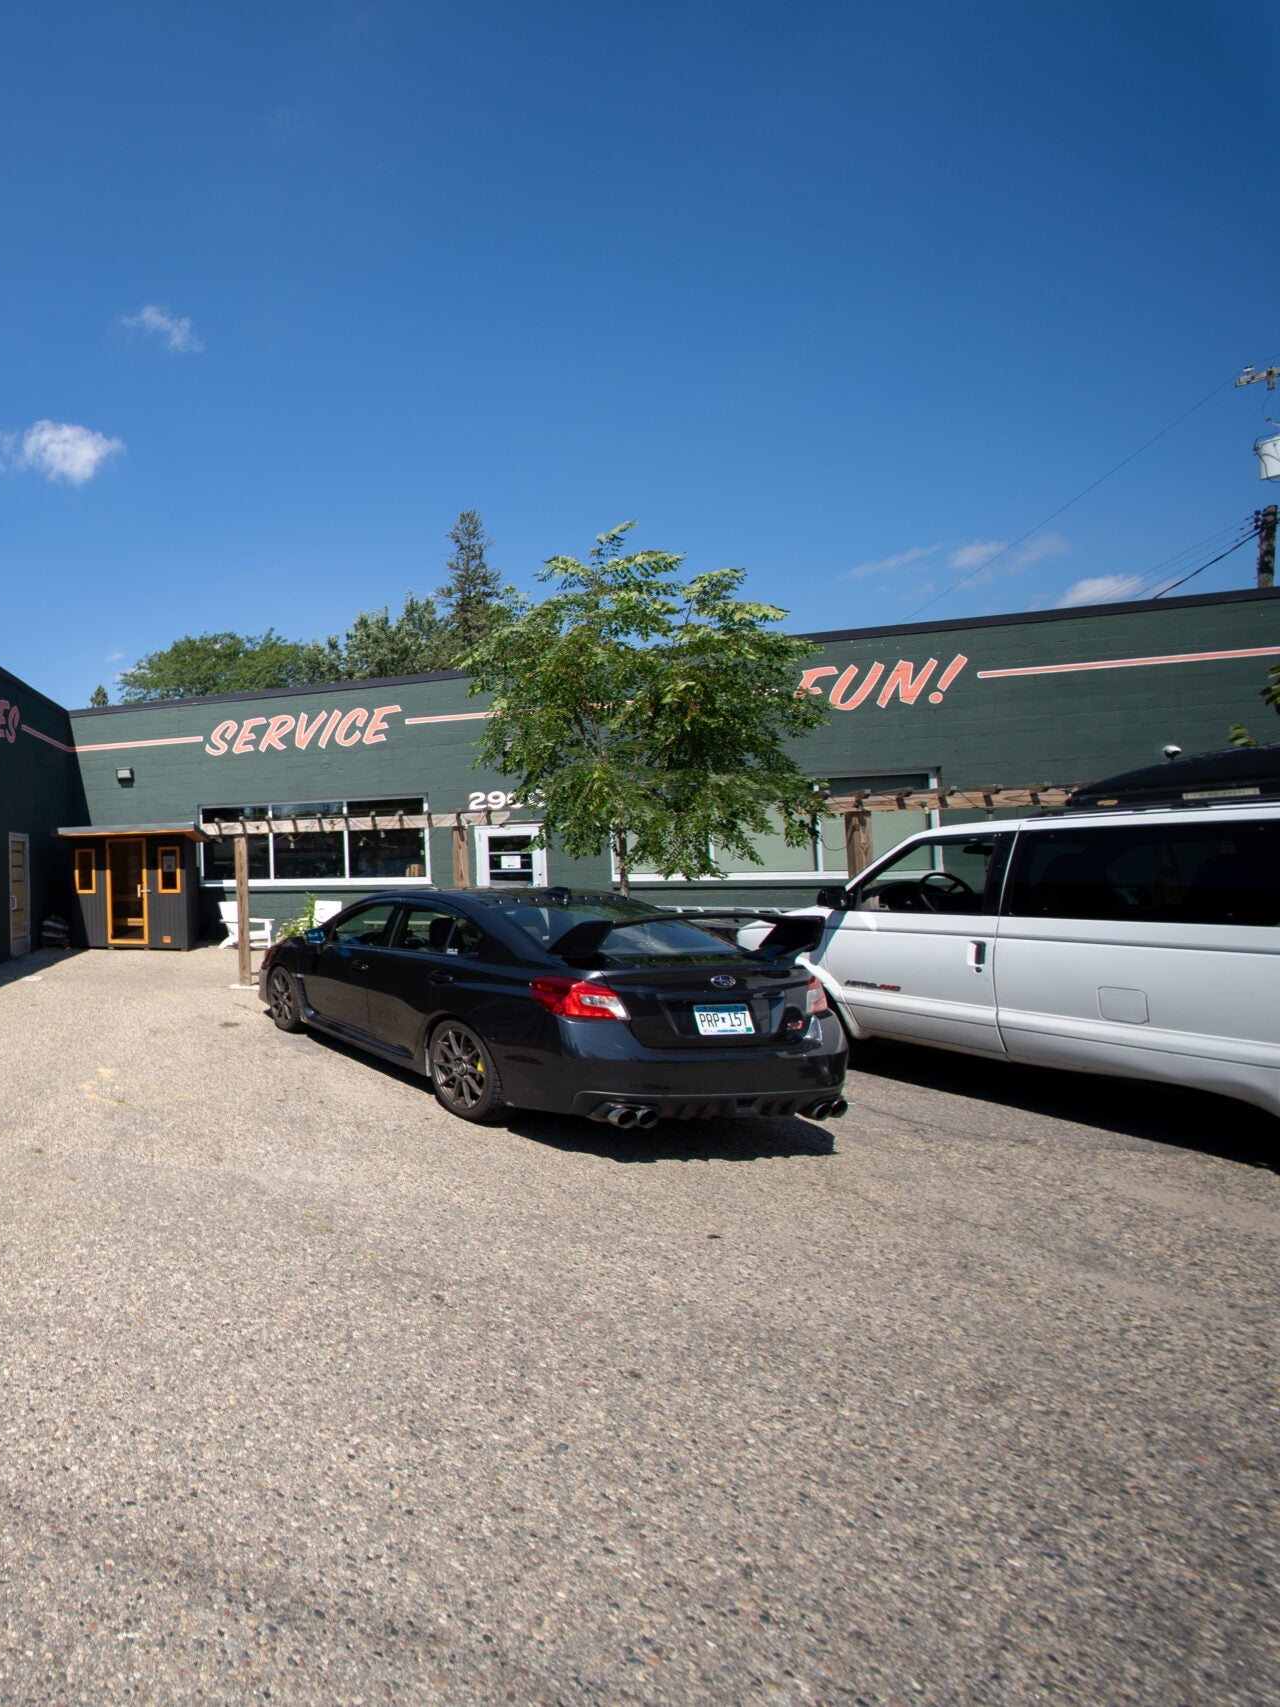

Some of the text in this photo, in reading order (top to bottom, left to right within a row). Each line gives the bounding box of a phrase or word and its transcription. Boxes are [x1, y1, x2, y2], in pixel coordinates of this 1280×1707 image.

[793, 654, 968, 710] FUN!
[205, 705, 403, 756] SERVICE
[699, 1012, 747, 1028] PRP 157
